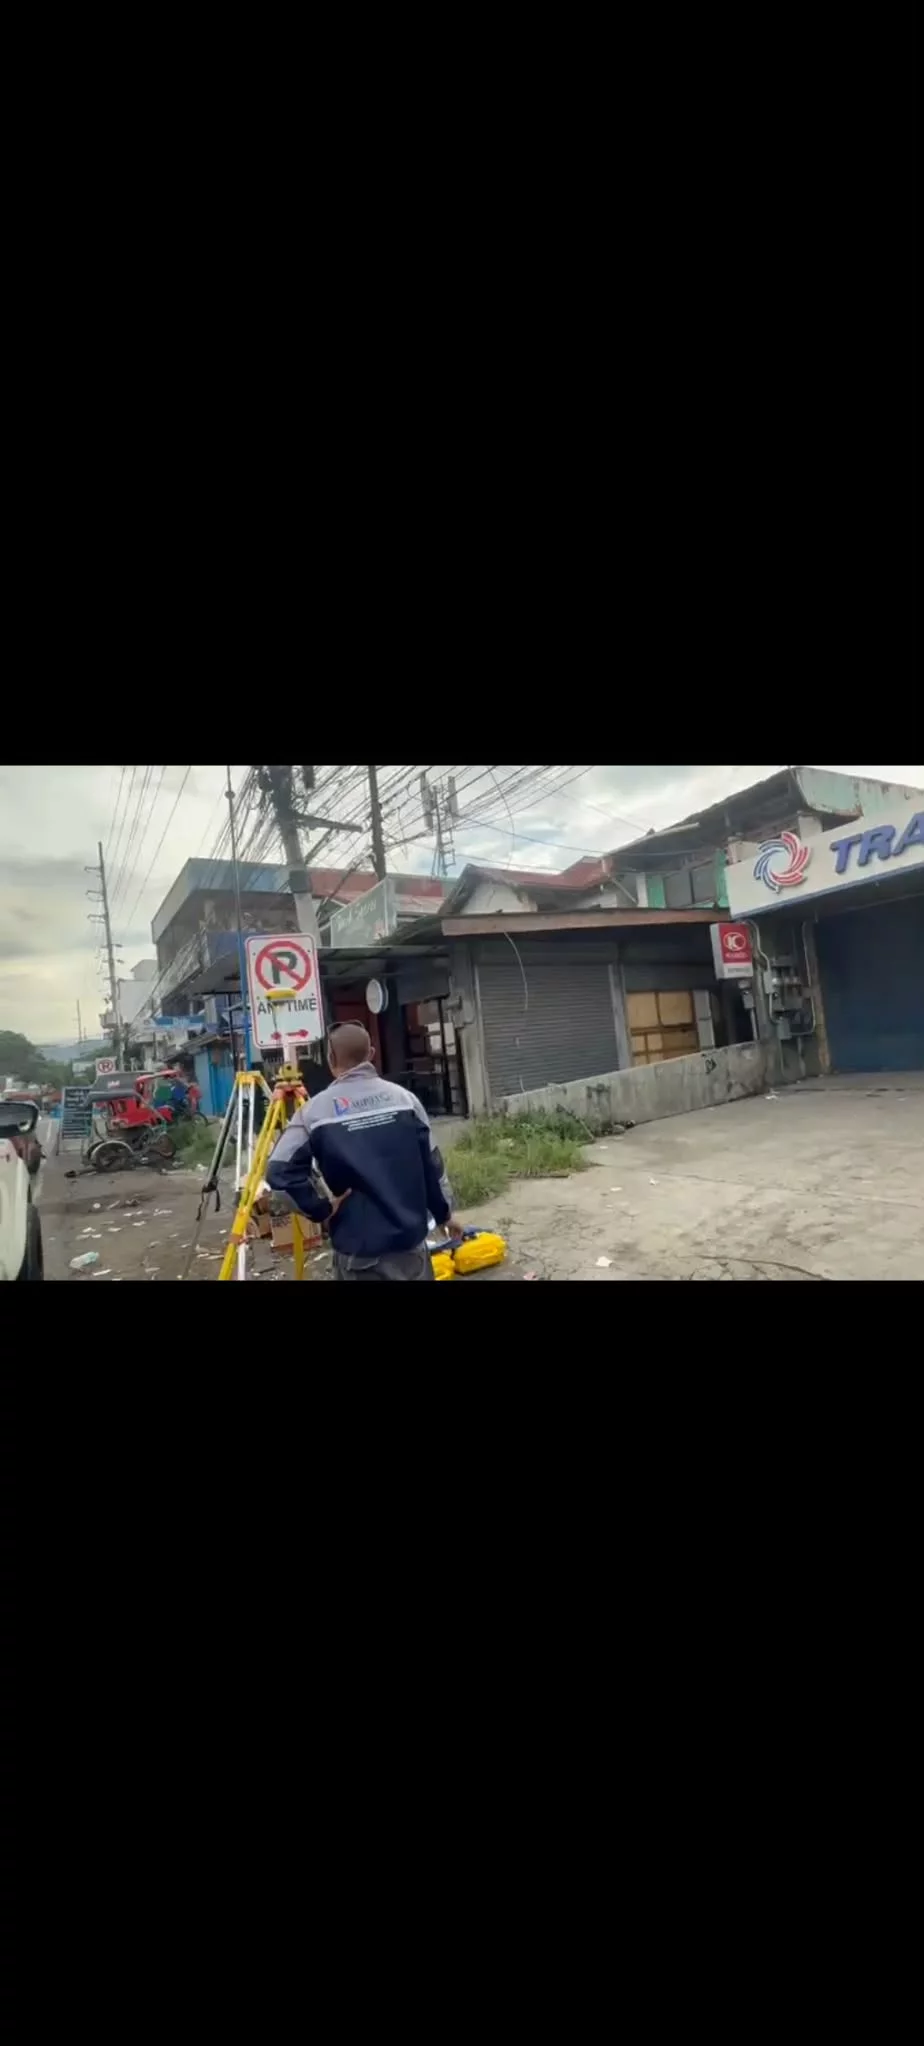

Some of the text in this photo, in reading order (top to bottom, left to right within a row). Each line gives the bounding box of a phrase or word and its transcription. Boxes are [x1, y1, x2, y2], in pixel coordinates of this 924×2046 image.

[829, 811, 924, 874] TRA
[270, 951, 298, 984] P
[286, 998, 317, 1012] TIME
